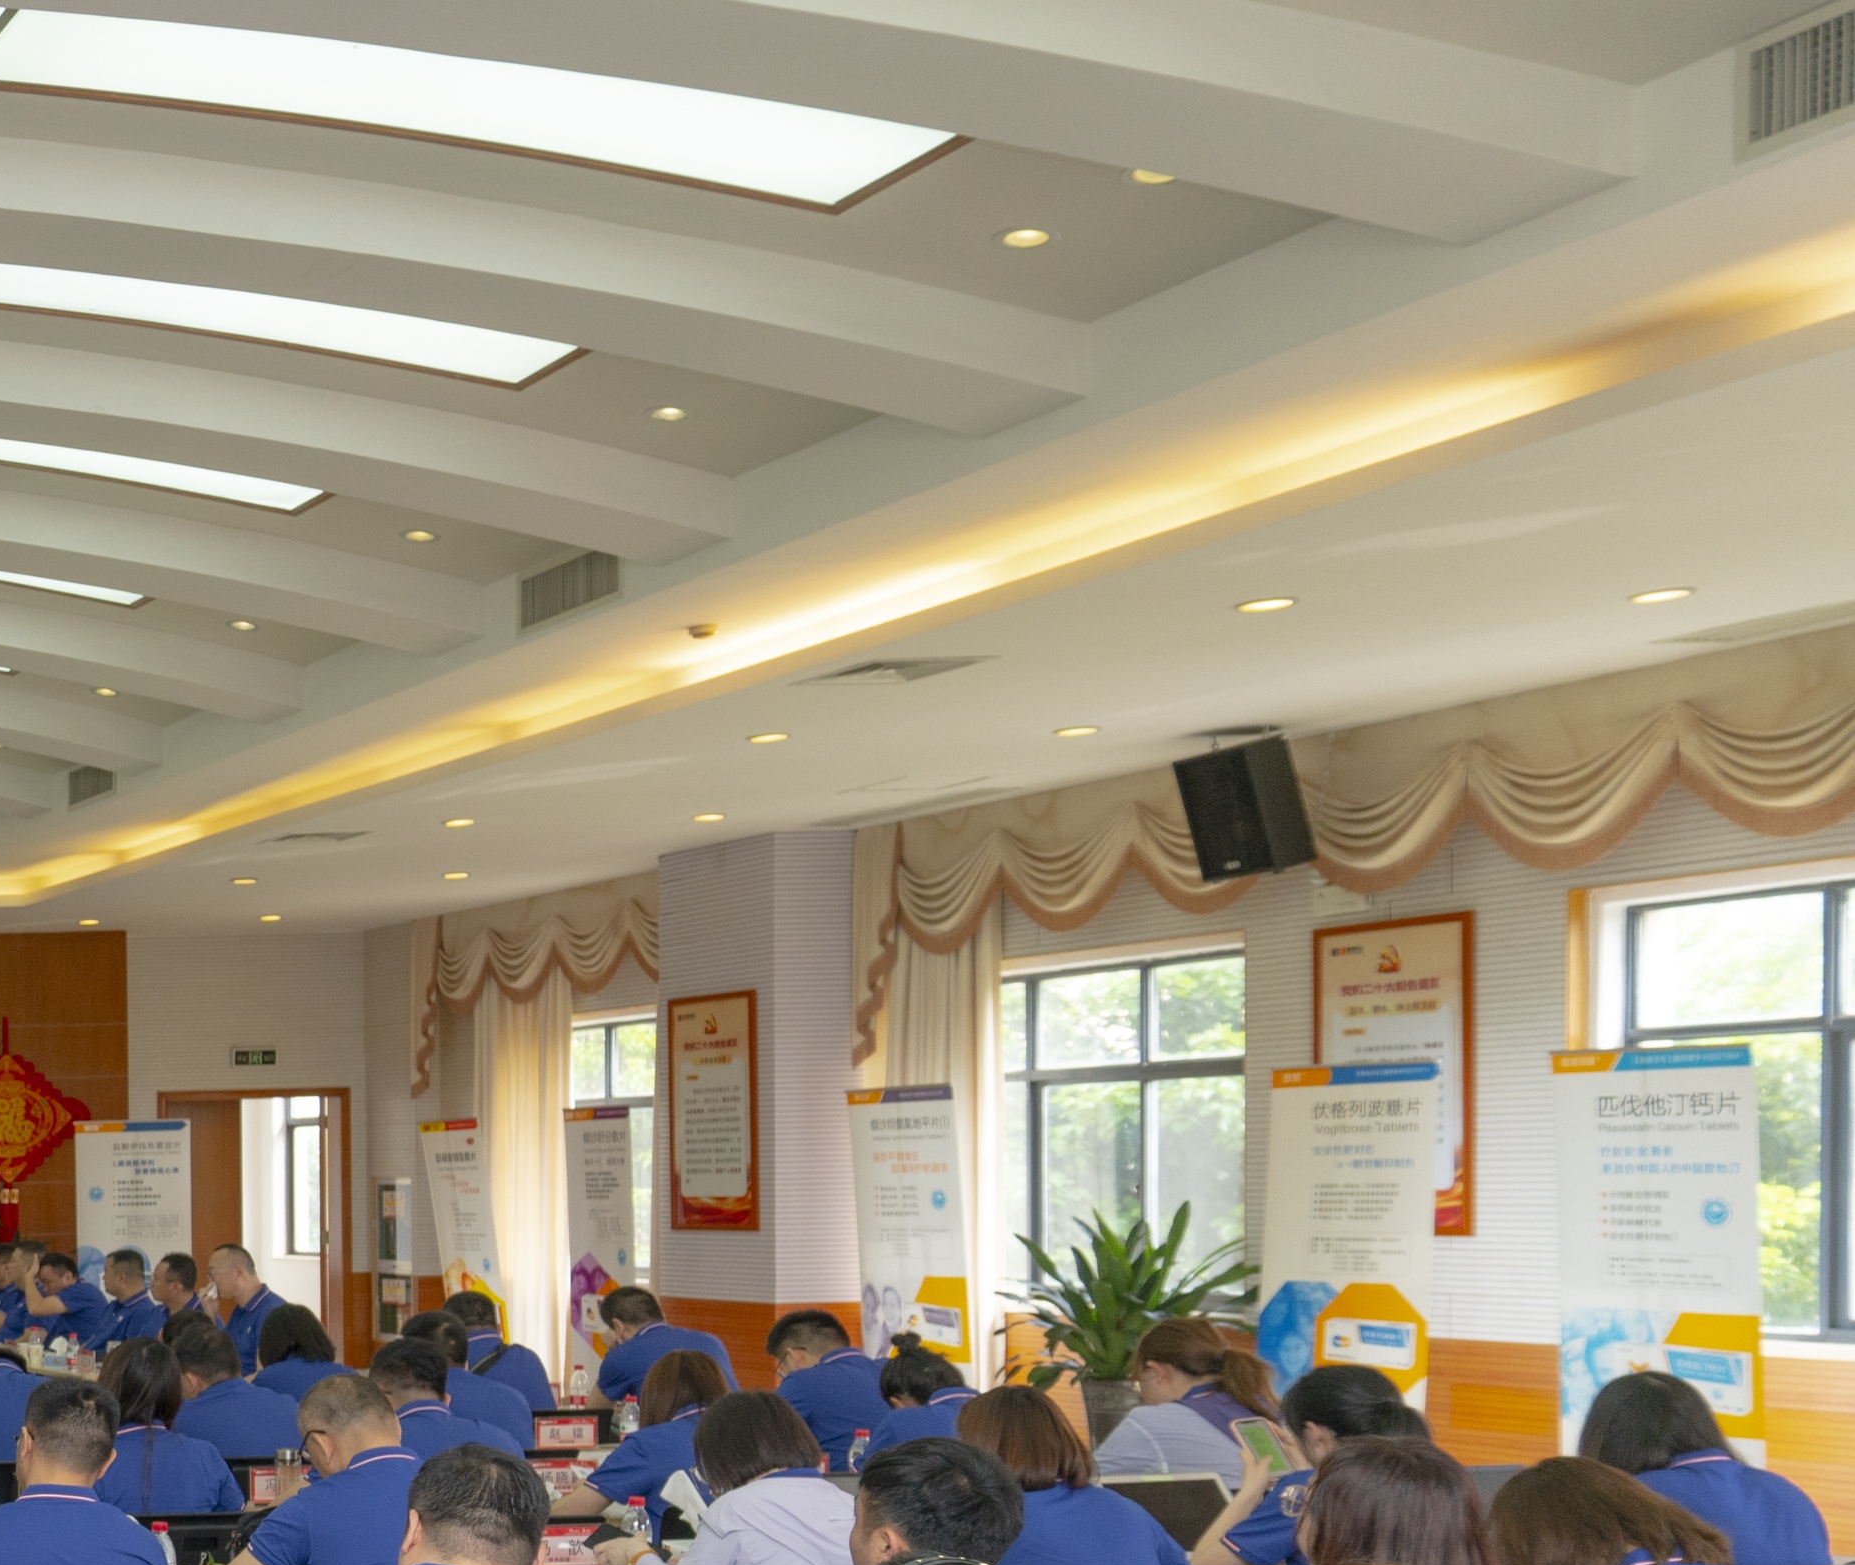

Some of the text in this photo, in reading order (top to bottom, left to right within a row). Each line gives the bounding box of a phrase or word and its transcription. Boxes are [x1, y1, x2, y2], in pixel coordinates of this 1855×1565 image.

[1313, 1097, 1423, 1121] 伏格列波糖片
[1597, 1091, 1741, 1119] 匹伐他汀钙片
[1315, 1121, 1420, 1137] Voglibose Tablets
[1598, 1121, 1740, 1134] Pitavastatin Calcium Tablets
